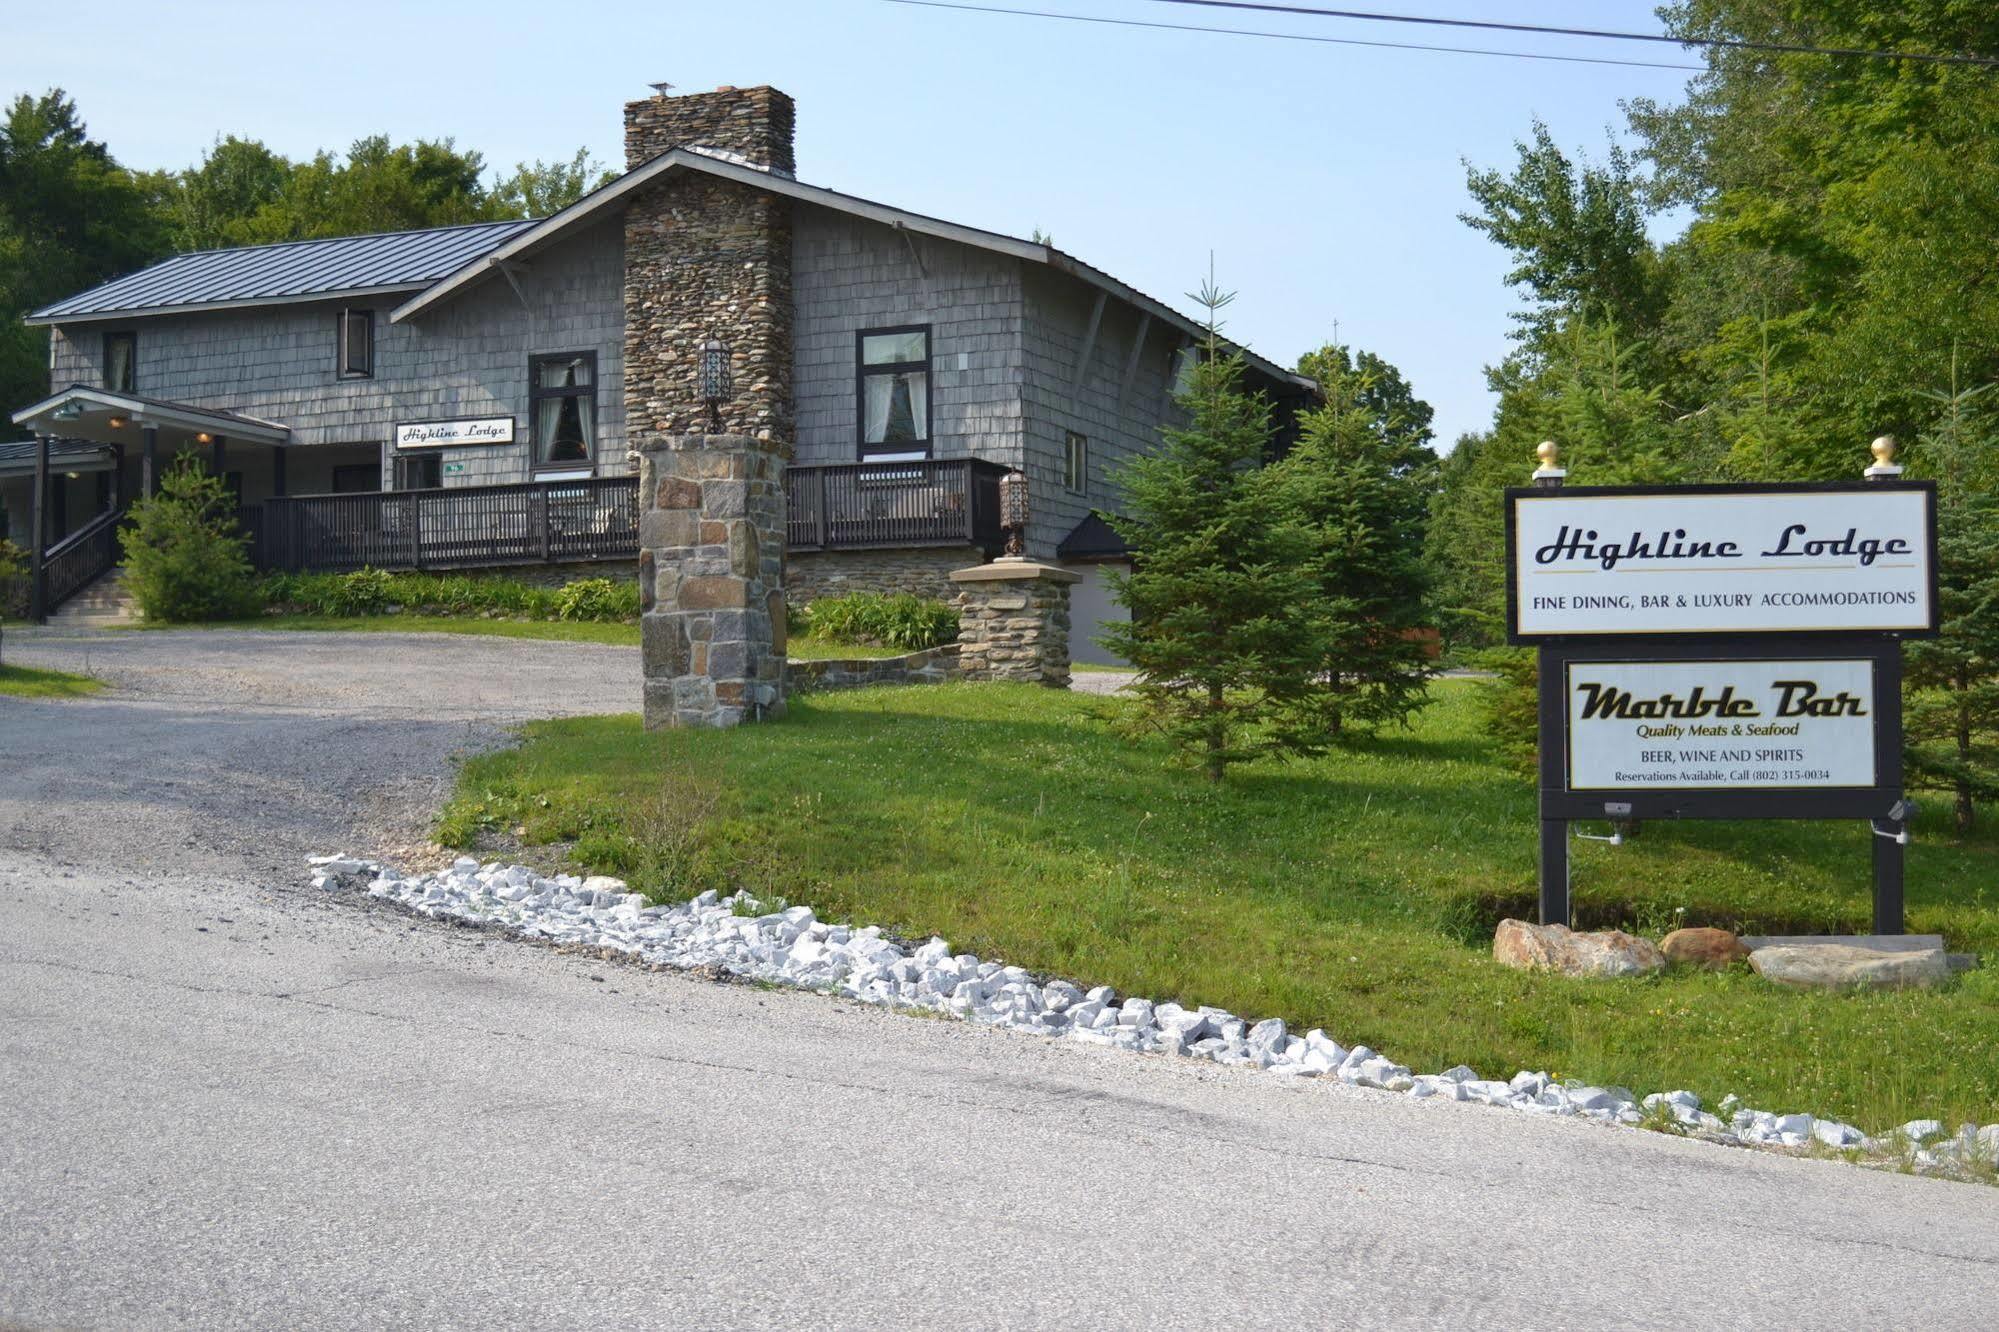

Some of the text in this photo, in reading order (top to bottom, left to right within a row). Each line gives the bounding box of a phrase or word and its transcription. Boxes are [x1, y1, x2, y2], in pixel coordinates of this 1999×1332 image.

[403, 424, 507, 442] Highline Lodge
[1535, 524, 1912, 570] Highline Lodge
[1533, 591, 1916, 611] FINE DINING, BAR & LUXURY ACCOMMODATIONS
[1576, 680, 1868, 719] Marble Bar
[1636, 722, 1800, 740] Quality Meats & Seafood
[1641, 749, 1804, 765] BEER, WINE AND SPIRITS
[1615, 770, 1830, 782] Reservations Available, Call (802) 315-0034
